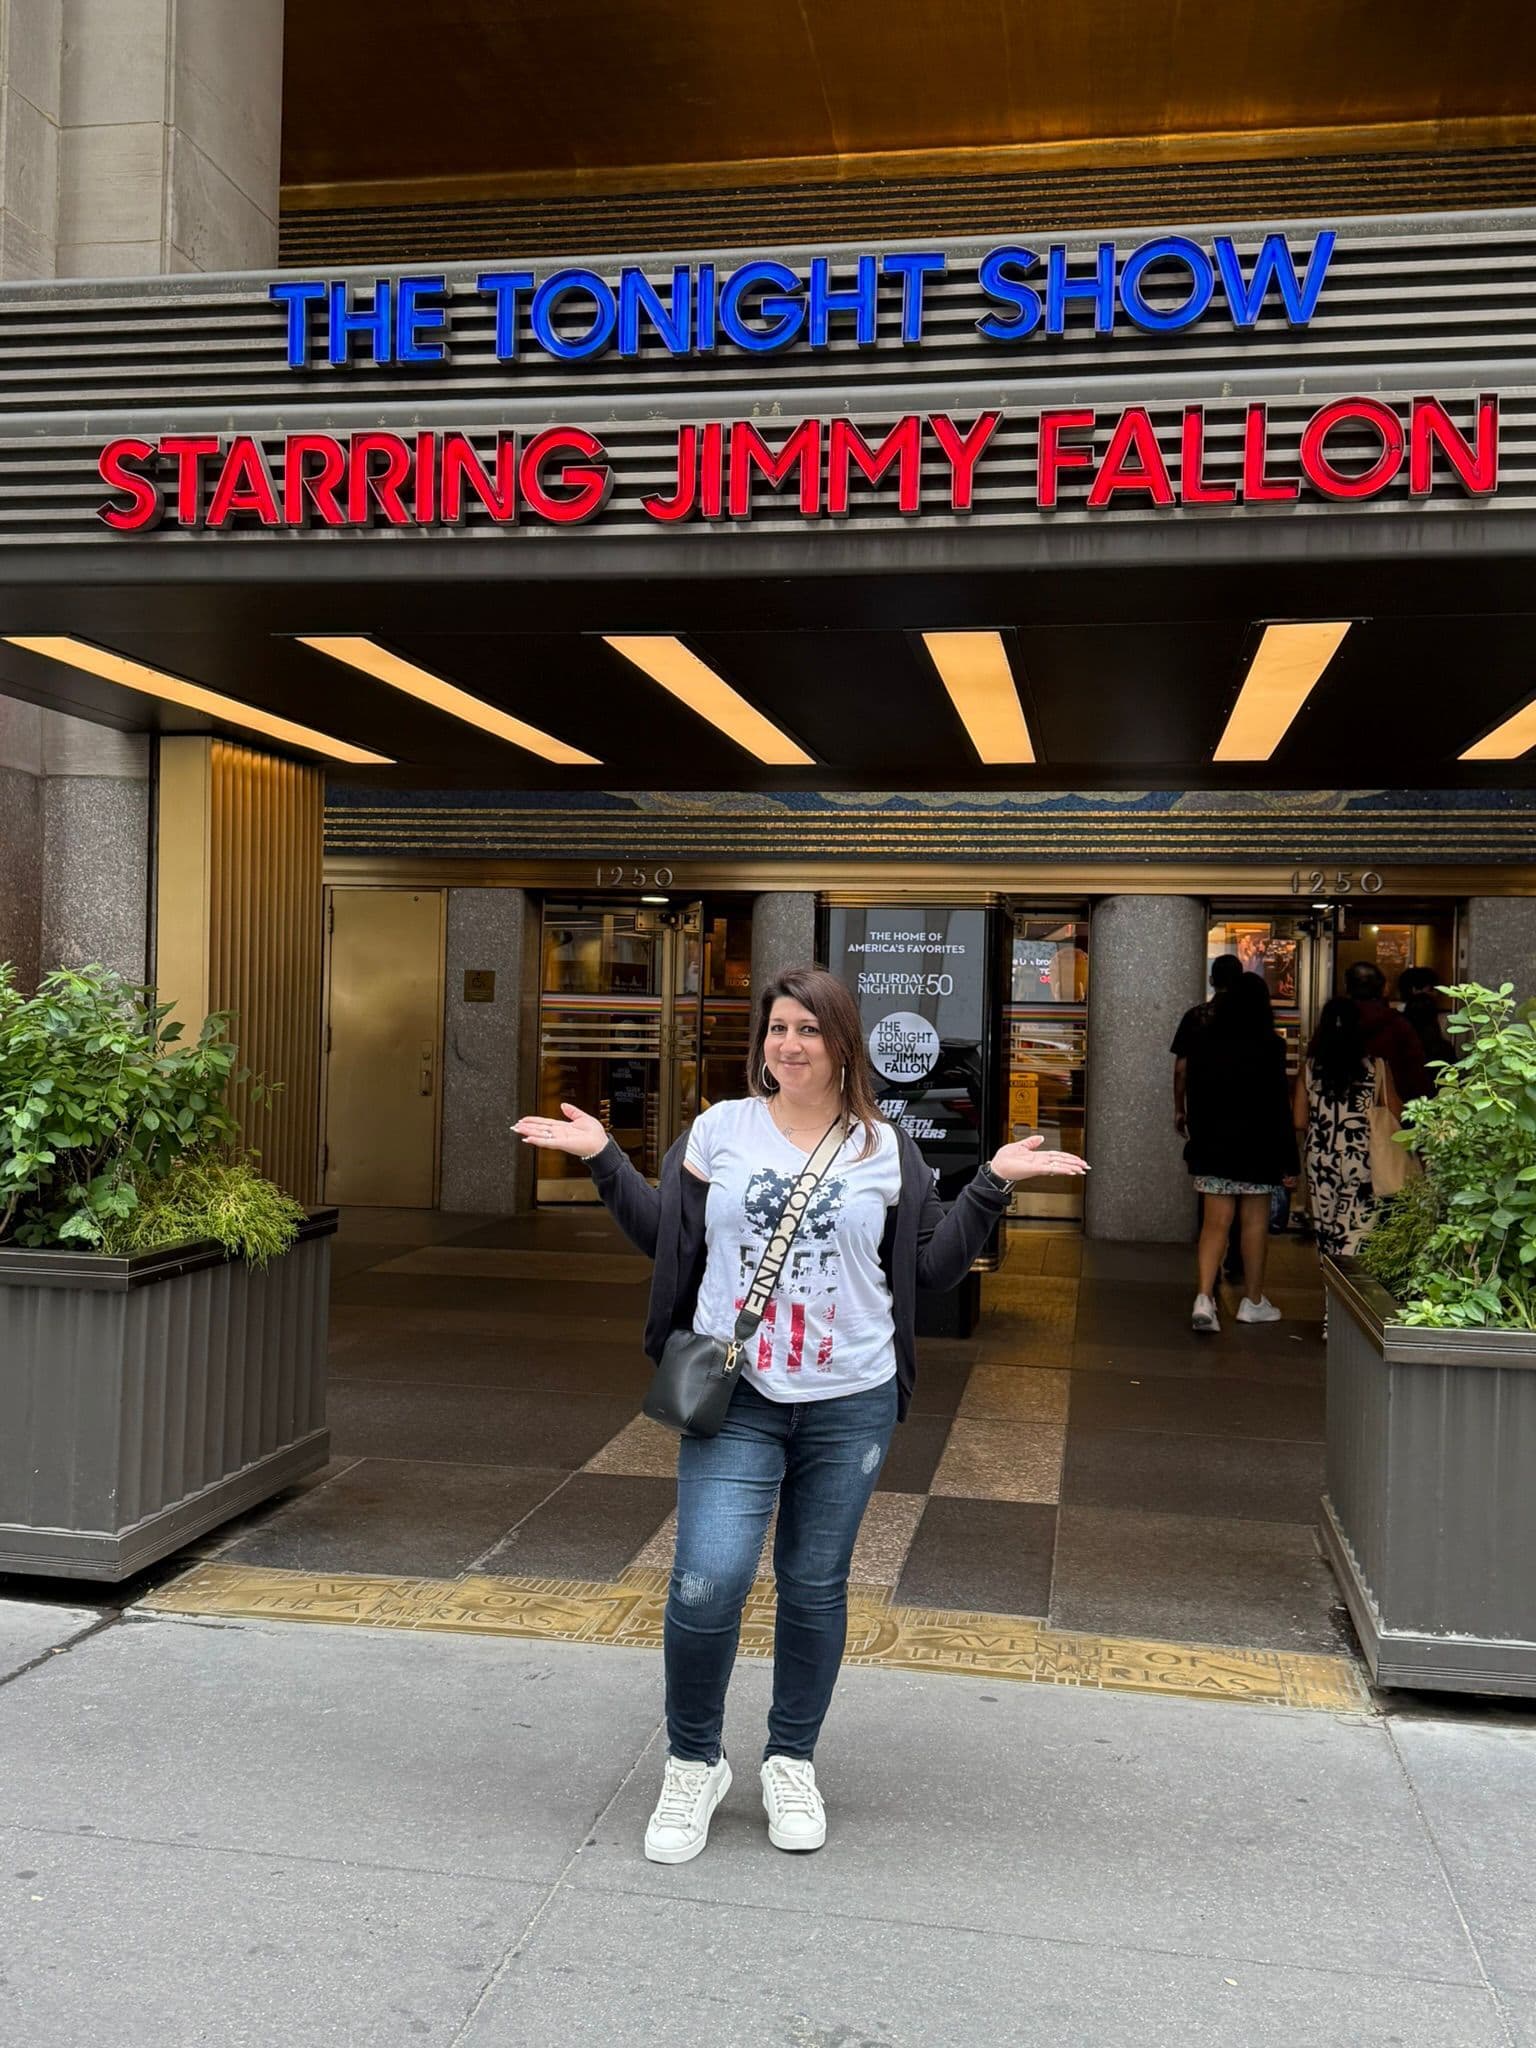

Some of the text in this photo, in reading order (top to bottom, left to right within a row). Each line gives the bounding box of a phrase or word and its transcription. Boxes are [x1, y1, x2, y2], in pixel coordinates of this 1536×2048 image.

[268, 230, 1337, 370] THE TONIGHT SHOW
[97, 393, 1499, 532] STARRING JIMMY FALLON
[595, 865, 674, 888] 1250
[1291, 871, 1384, 894] 1250
[869, 931, 943, 942] THE HOME OF
[847, 943, 966, 954] AMERICA'S FAVORITES
[858, 972, 926, 985] SATURDAY
[926, 973, 953, 996] 50
[878, 1021, 901, 1032] THE
[877, 1031, 933, 1043] TONIGHT
[877, 1042, 916, 1053] SHOW
[892, 1053, 933, 1064] JIMMY
[884, 1062, 930, 1074] FALLON
[900, 1119, 934, 1129] SETH
[904, 1128, 947, 1139] EYERS
[336, 1601, 556, 1628] AMERICAS
[944, 1634, 1126, 1662] AVENUE
[1006, 1656, 1252, 1693] AMERICAS
